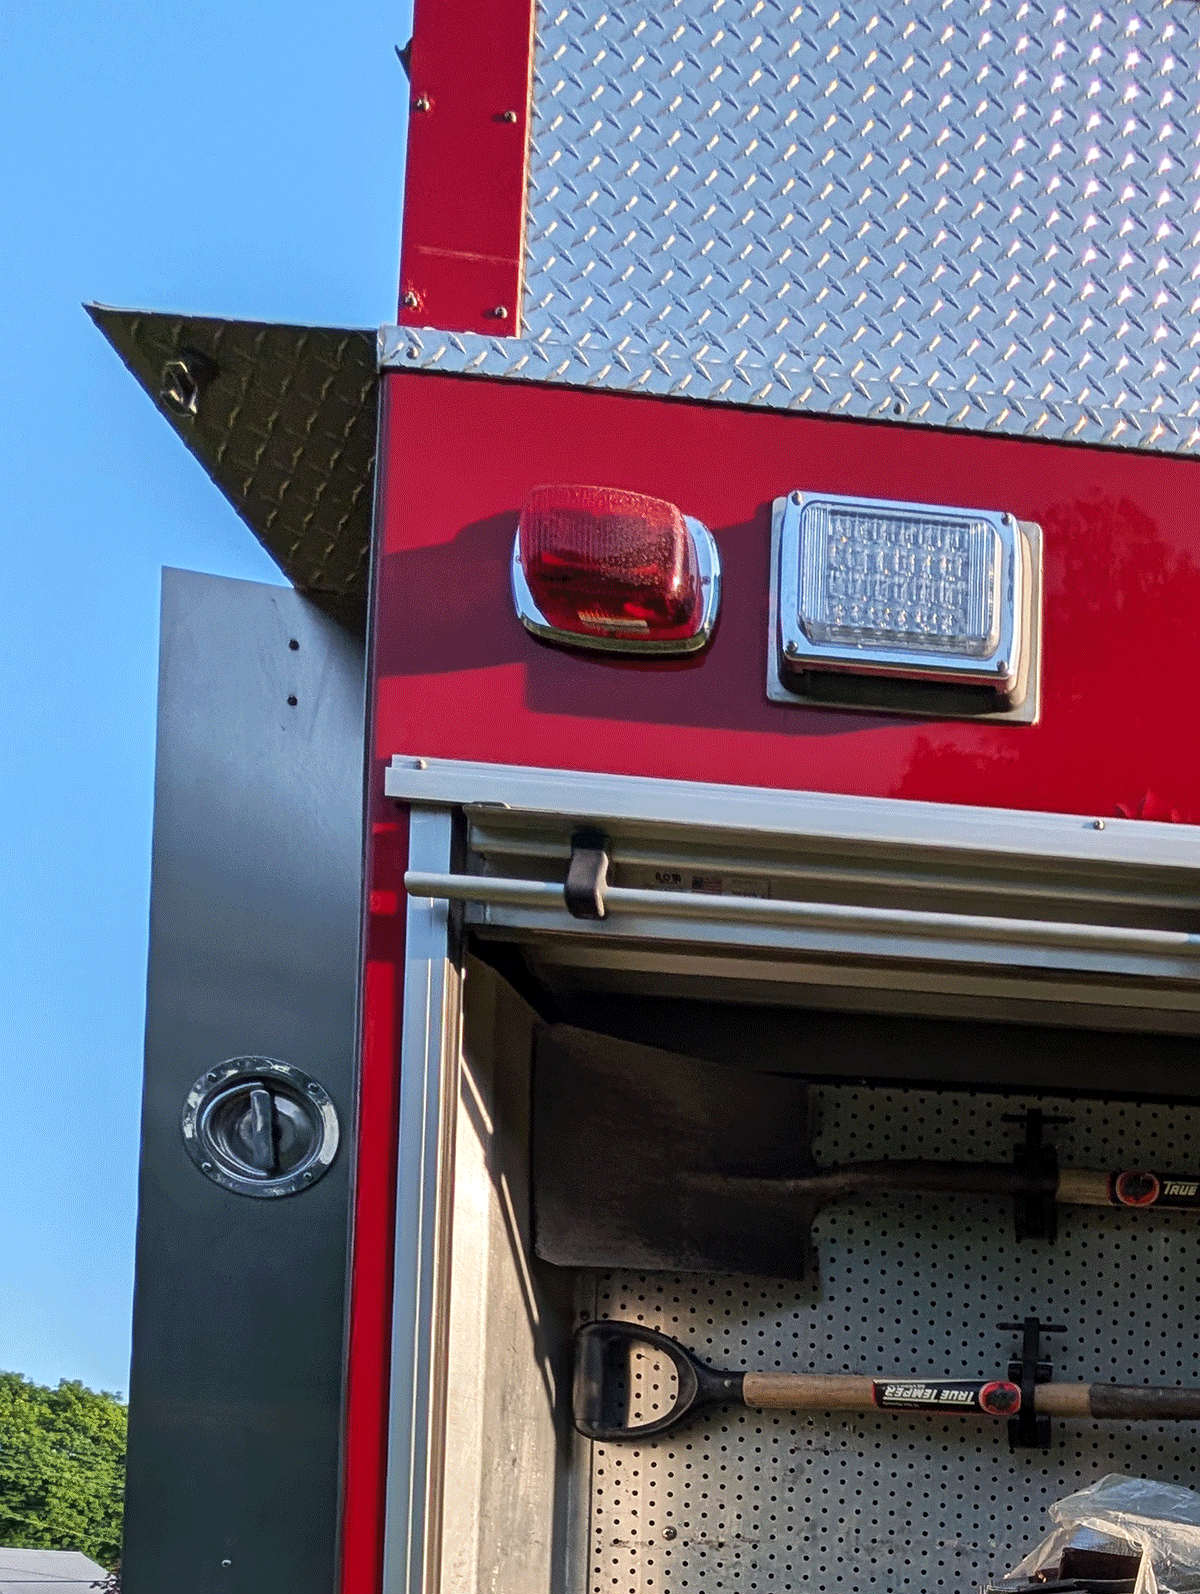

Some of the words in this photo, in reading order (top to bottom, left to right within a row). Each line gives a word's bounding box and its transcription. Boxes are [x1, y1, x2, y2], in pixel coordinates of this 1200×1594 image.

[1163, 1180, 1199, 1196] TRUE
[882, 1386, 938, 1403] TEMPER
[939, 1389, 975, 1405] TRUE
